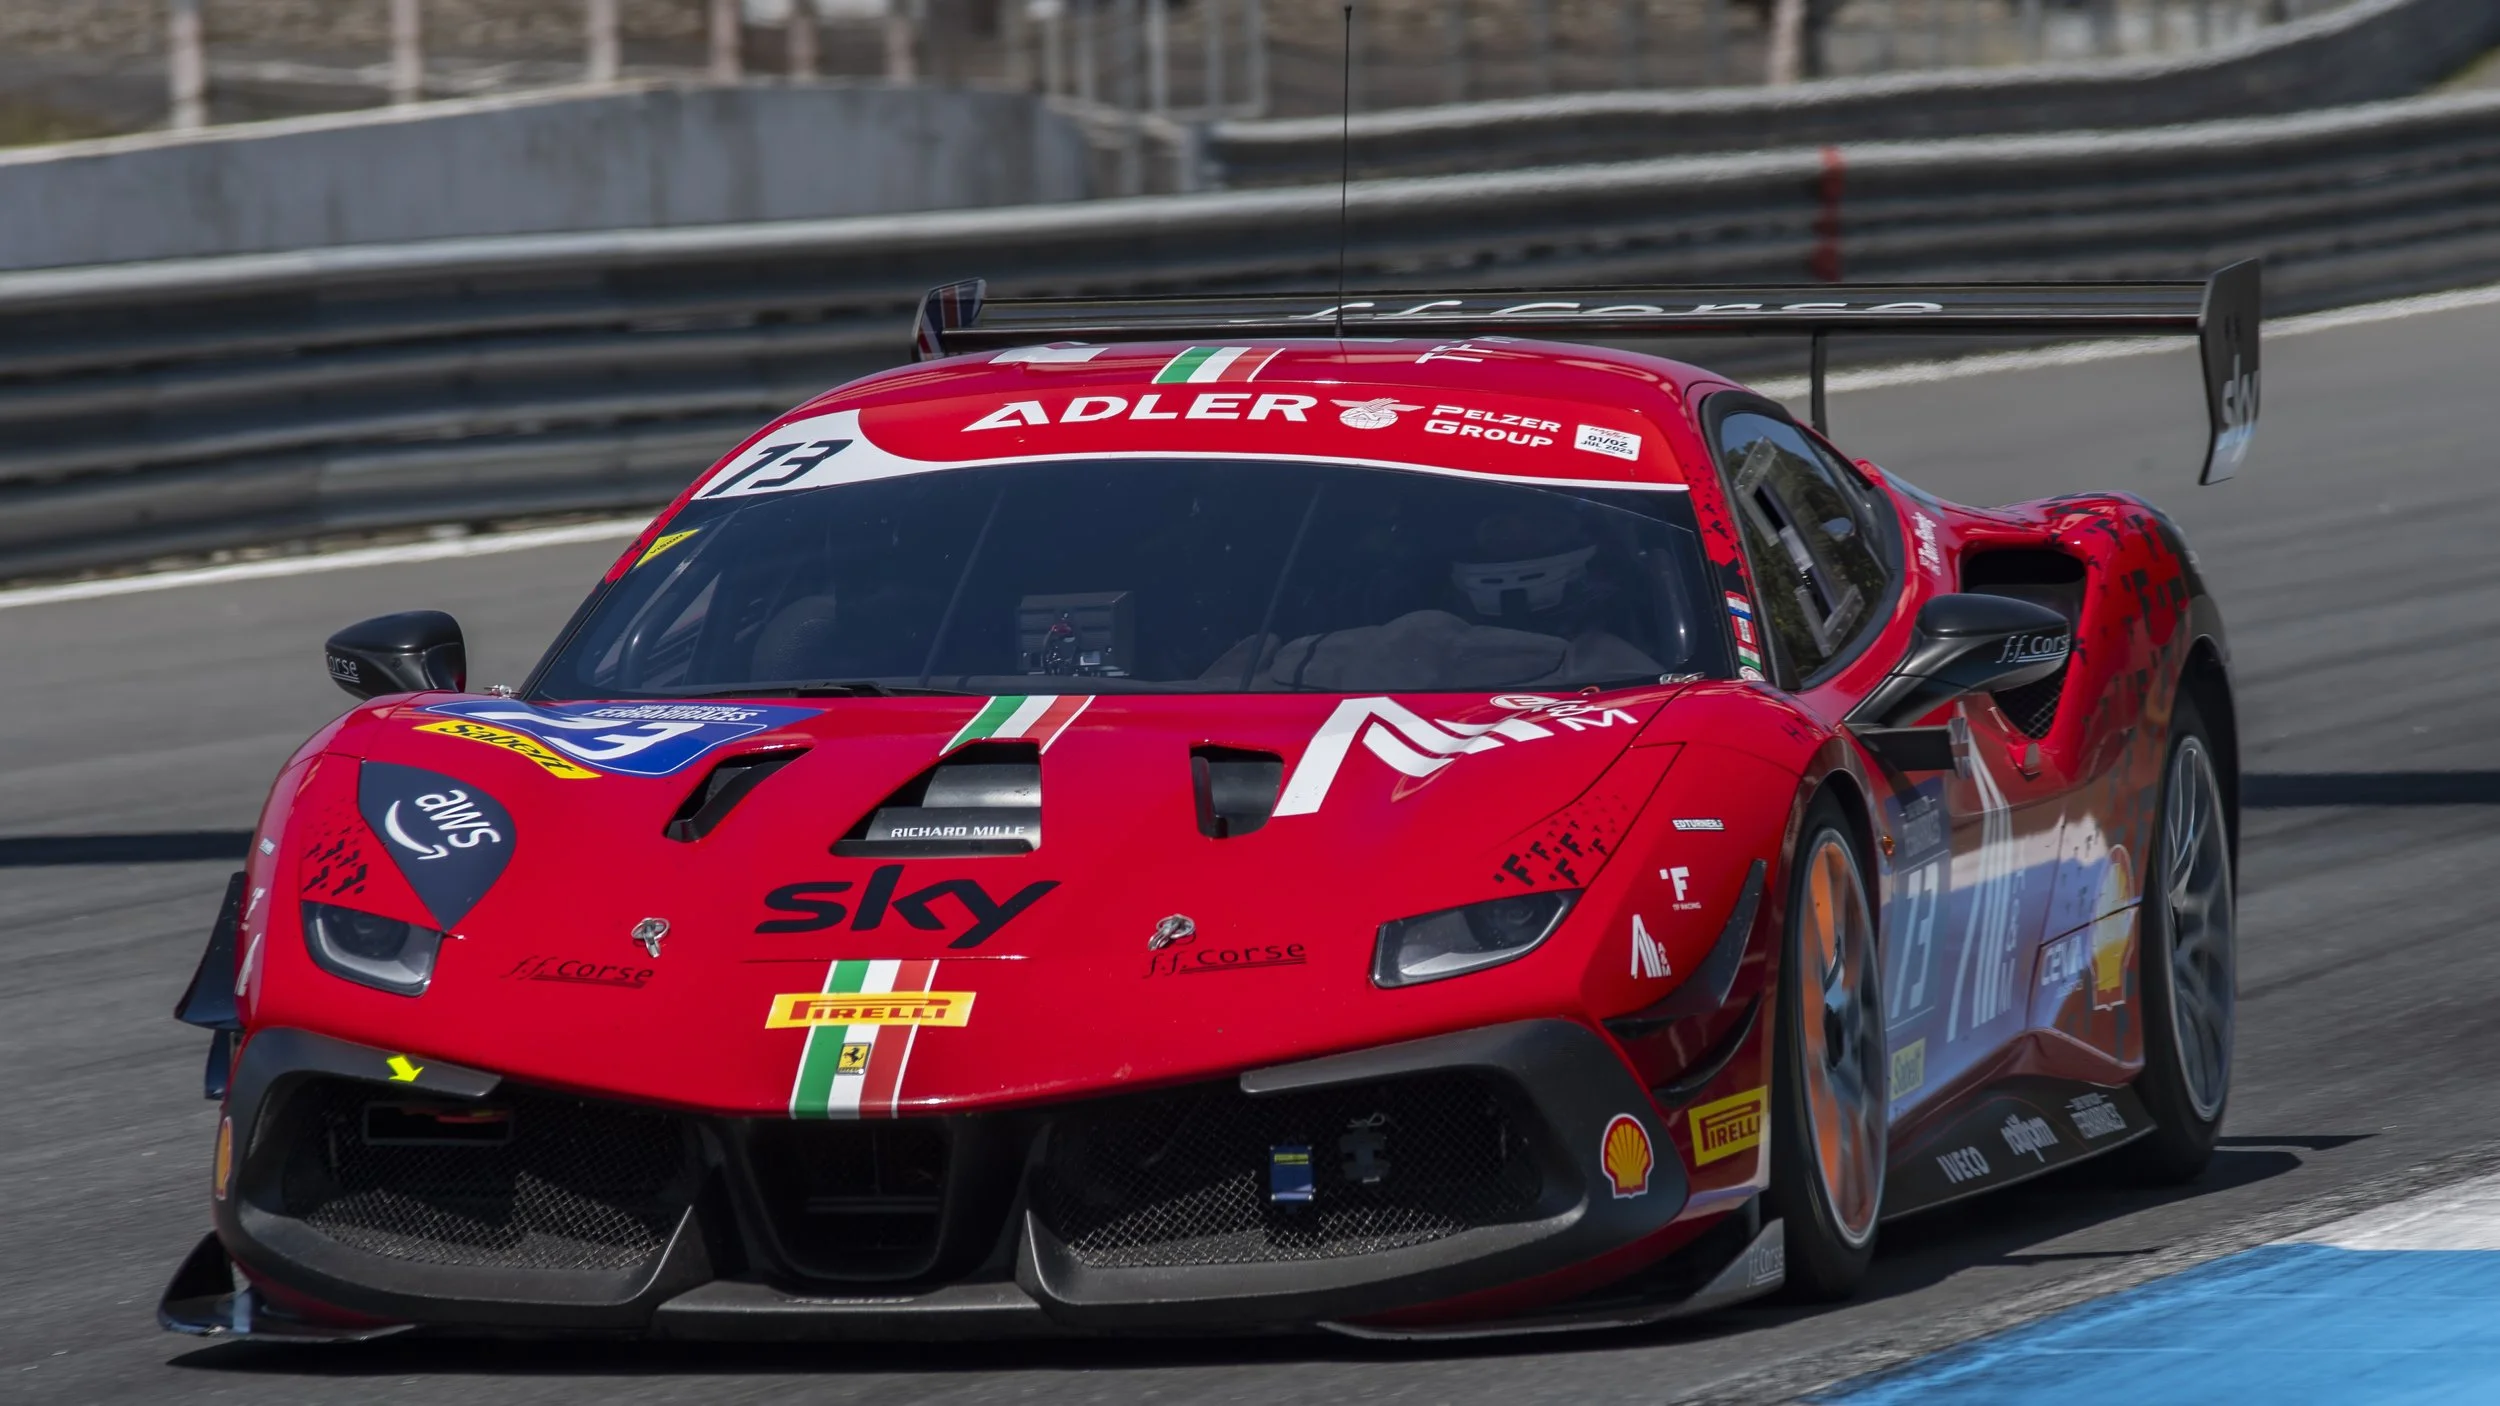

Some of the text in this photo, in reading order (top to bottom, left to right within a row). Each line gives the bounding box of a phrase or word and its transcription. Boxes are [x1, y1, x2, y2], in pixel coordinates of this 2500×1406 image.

[961, 393, 1318, 432] ADLER
[1432, 404, 1561, 433] PELZER
[1424, 419, 1554, 448] GROUP
[1587, 434, 1628, 448] 01/02
[1580, 440, 1601, 449] JUL
[1604, 444, 1634, 455] 2023
[649, 534, 684, 554] VISION
[2030, 633, 2071, 655] Cors
[328, 655, 359, 677] orse
[441, 724, 576, 772] Sabelt
[415, 789, 501, 848] aws
[891, 826, 1024, 838] RICHARD MILLE
[755, 864, 1061, 949] sky
[1196, 943, 1305, 965] Corse
[557, 960, 654, 982] Corse
[789, 998, 951, 1020] PIRELLI
[1699, 1099, 1761, 1152] PIRELLI
[1936, 1146, 1990, 1184] IVECO
